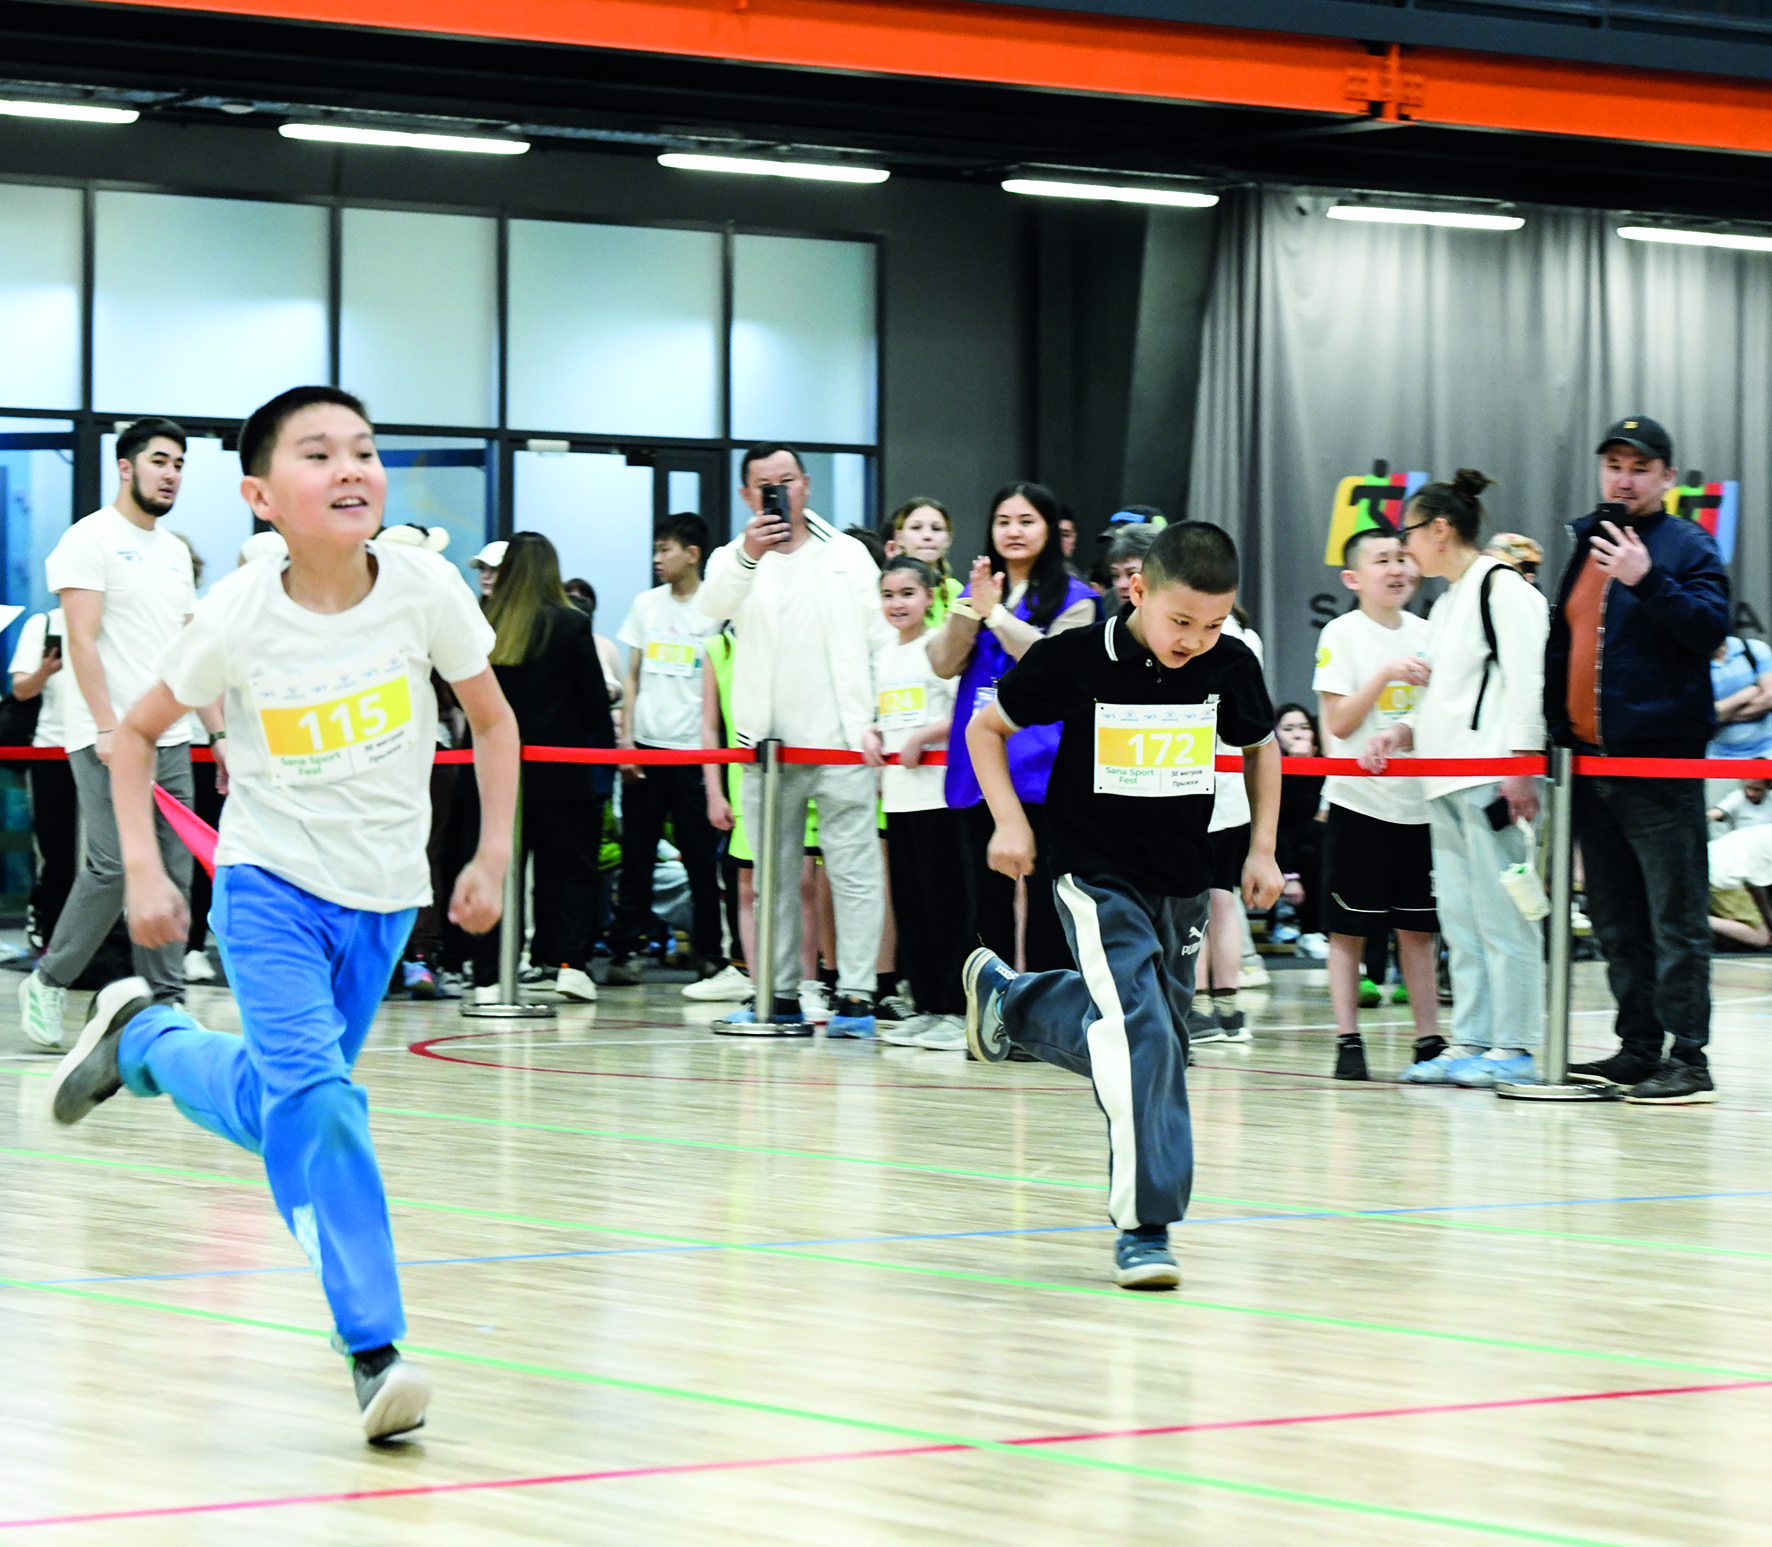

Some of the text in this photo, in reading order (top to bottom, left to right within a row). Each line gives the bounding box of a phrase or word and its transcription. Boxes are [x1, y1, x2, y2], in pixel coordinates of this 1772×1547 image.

[297, 692, 388, 751] 115
[1128, 732, 1195, 765] 172
[280, 752, 341, 767] Sana Sport
[299, 766, 322, 776] Fest
[1106, 767, 1154, 777] Sana Sport
[1119, 776, 1138, 784] Fest
